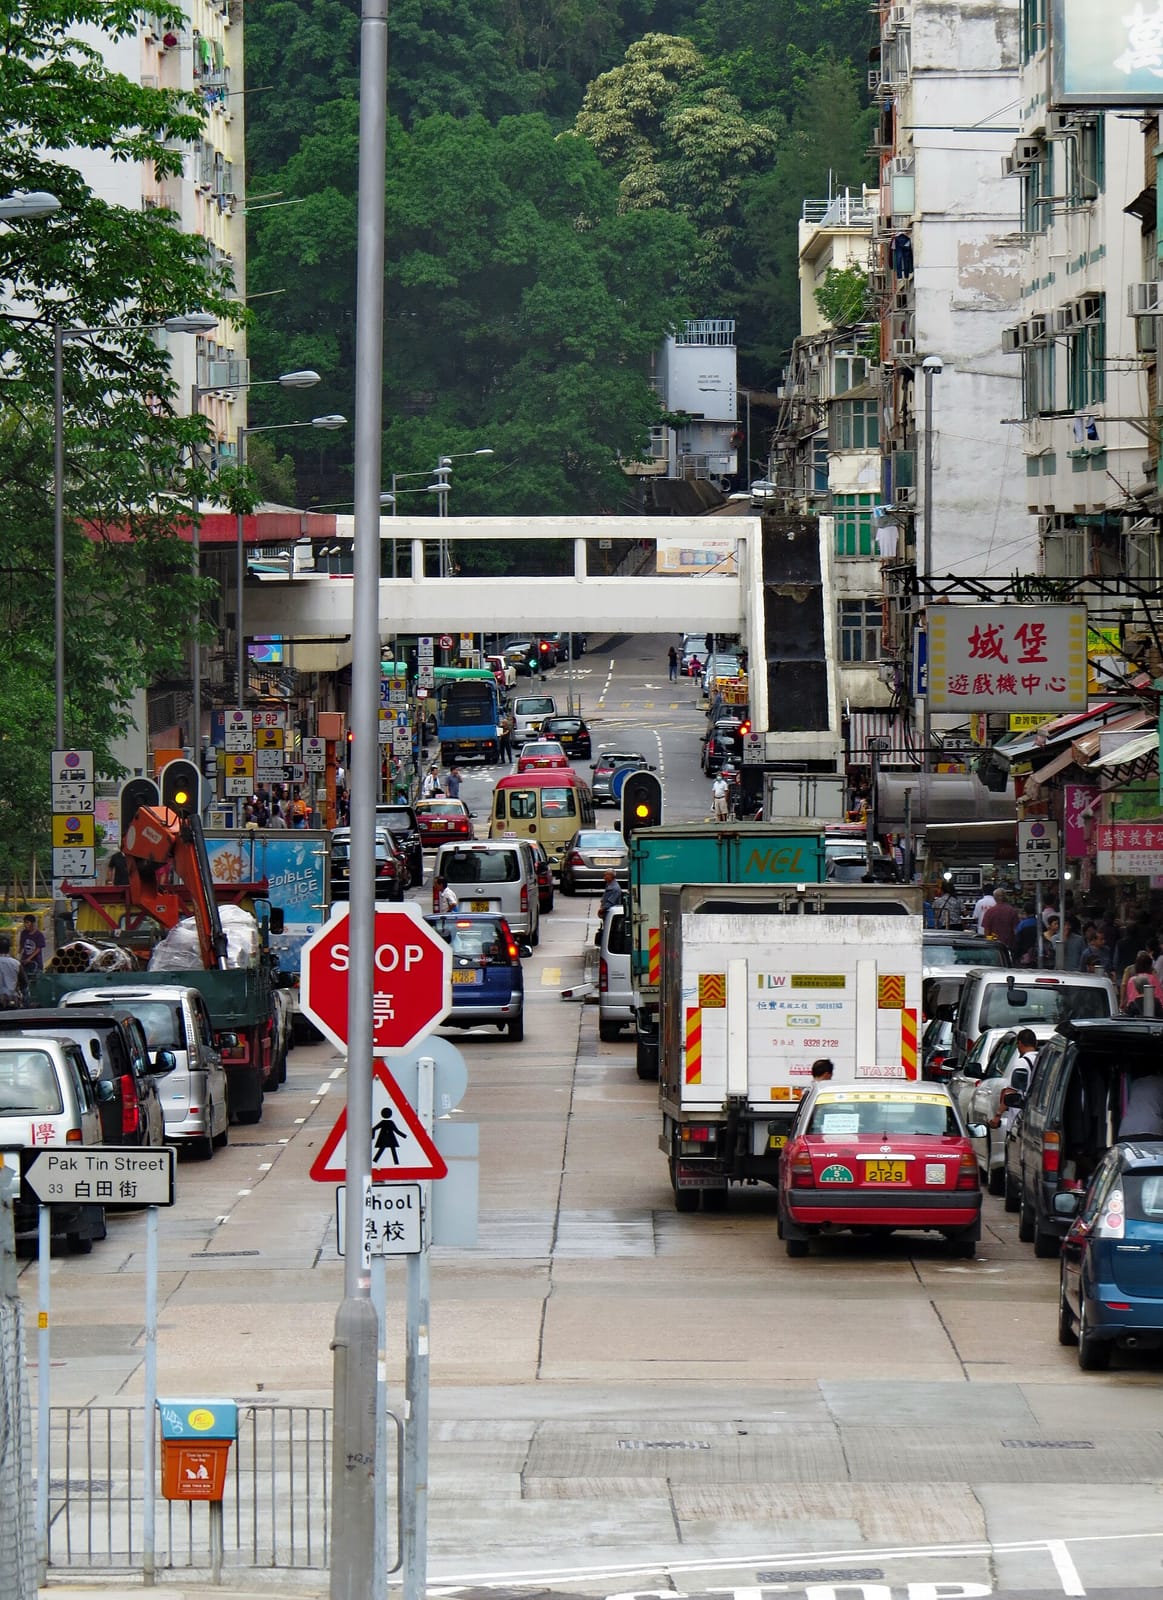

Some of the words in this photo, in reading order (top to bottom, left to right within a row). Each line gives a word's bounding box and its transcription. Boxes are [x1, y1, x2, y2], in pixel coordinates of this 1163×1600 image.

[78, 785, 85, 795] 7
[79, 801, 92, 810] 12
[80, 850, 86, 859] 7
[1044, 854, 1050, 863] 7
[80, 865, 86, 874] 7
[1045, 869, 1057, 878] 12
[268, 868, 313, 888] EDIBLE
[294, 880, 318, 894] ICE
[330, 944, 424, 972] SOP
[860, 1066, 902, 1076] TAXI
[36, 1123, 56, 1144] 學
[48, 1157, 78, 1170] Pak
[85, 1157, 108, 1170] Tin
[114, 1157, 164, 1170] Street
[877, 1161, 895, 1171] LY
[869, 1171, 903, 1181] 2129
[49, 1184, 63, 1194] 33
[75, 1180, 138, 1198] 白田街
[371, 1195, 412, 1210] hool
